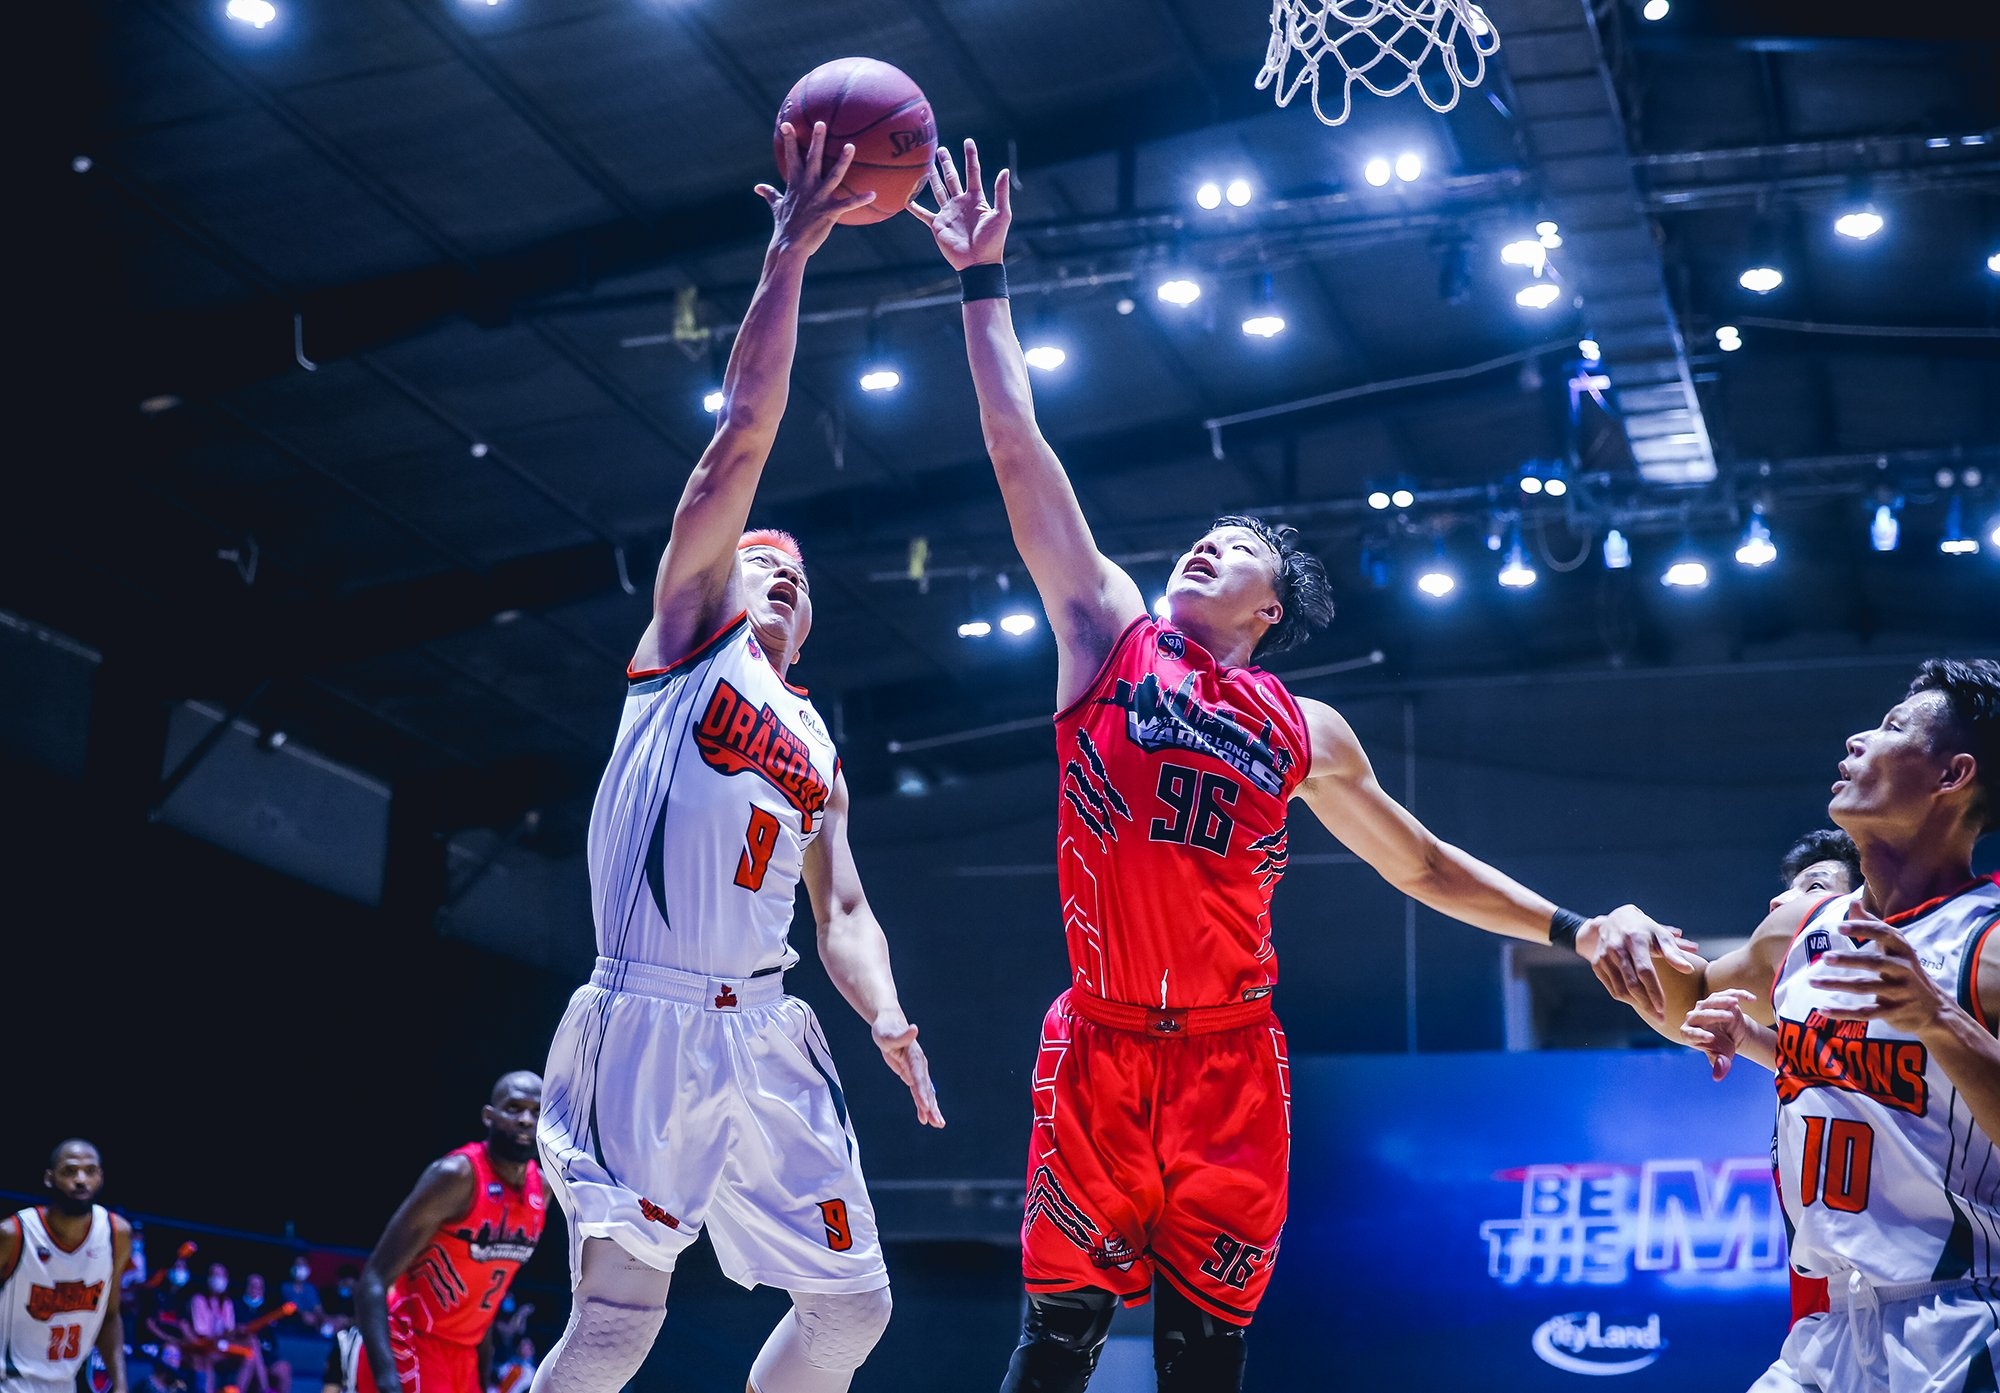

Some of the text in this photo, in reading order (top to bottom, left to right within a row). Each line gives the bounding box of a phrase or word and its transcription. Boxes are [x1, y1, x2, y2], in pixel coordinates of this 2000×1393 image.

[762, 706, 809, 757] DA NANG
[1215, 738, 1250, 760] LONG
[1149, 761, 1240, 857] 96
[733, 803, 781, 893] 9
[1810, 936, 1829, 950] VBA
[1806, 1010, 1827, 1031] DA
[1521, 1163, 1626, 1219] BE
[1801, 1116, 1874, 1214] 10
[815, 1198, 852, 1252] 9
[1479, 1218, 1628, 1285] THE
[1200, 1232, 1268, 1291] 96
[481, 1269, 505, 1311] 2
[48, 1325, 81, 1361] 23
